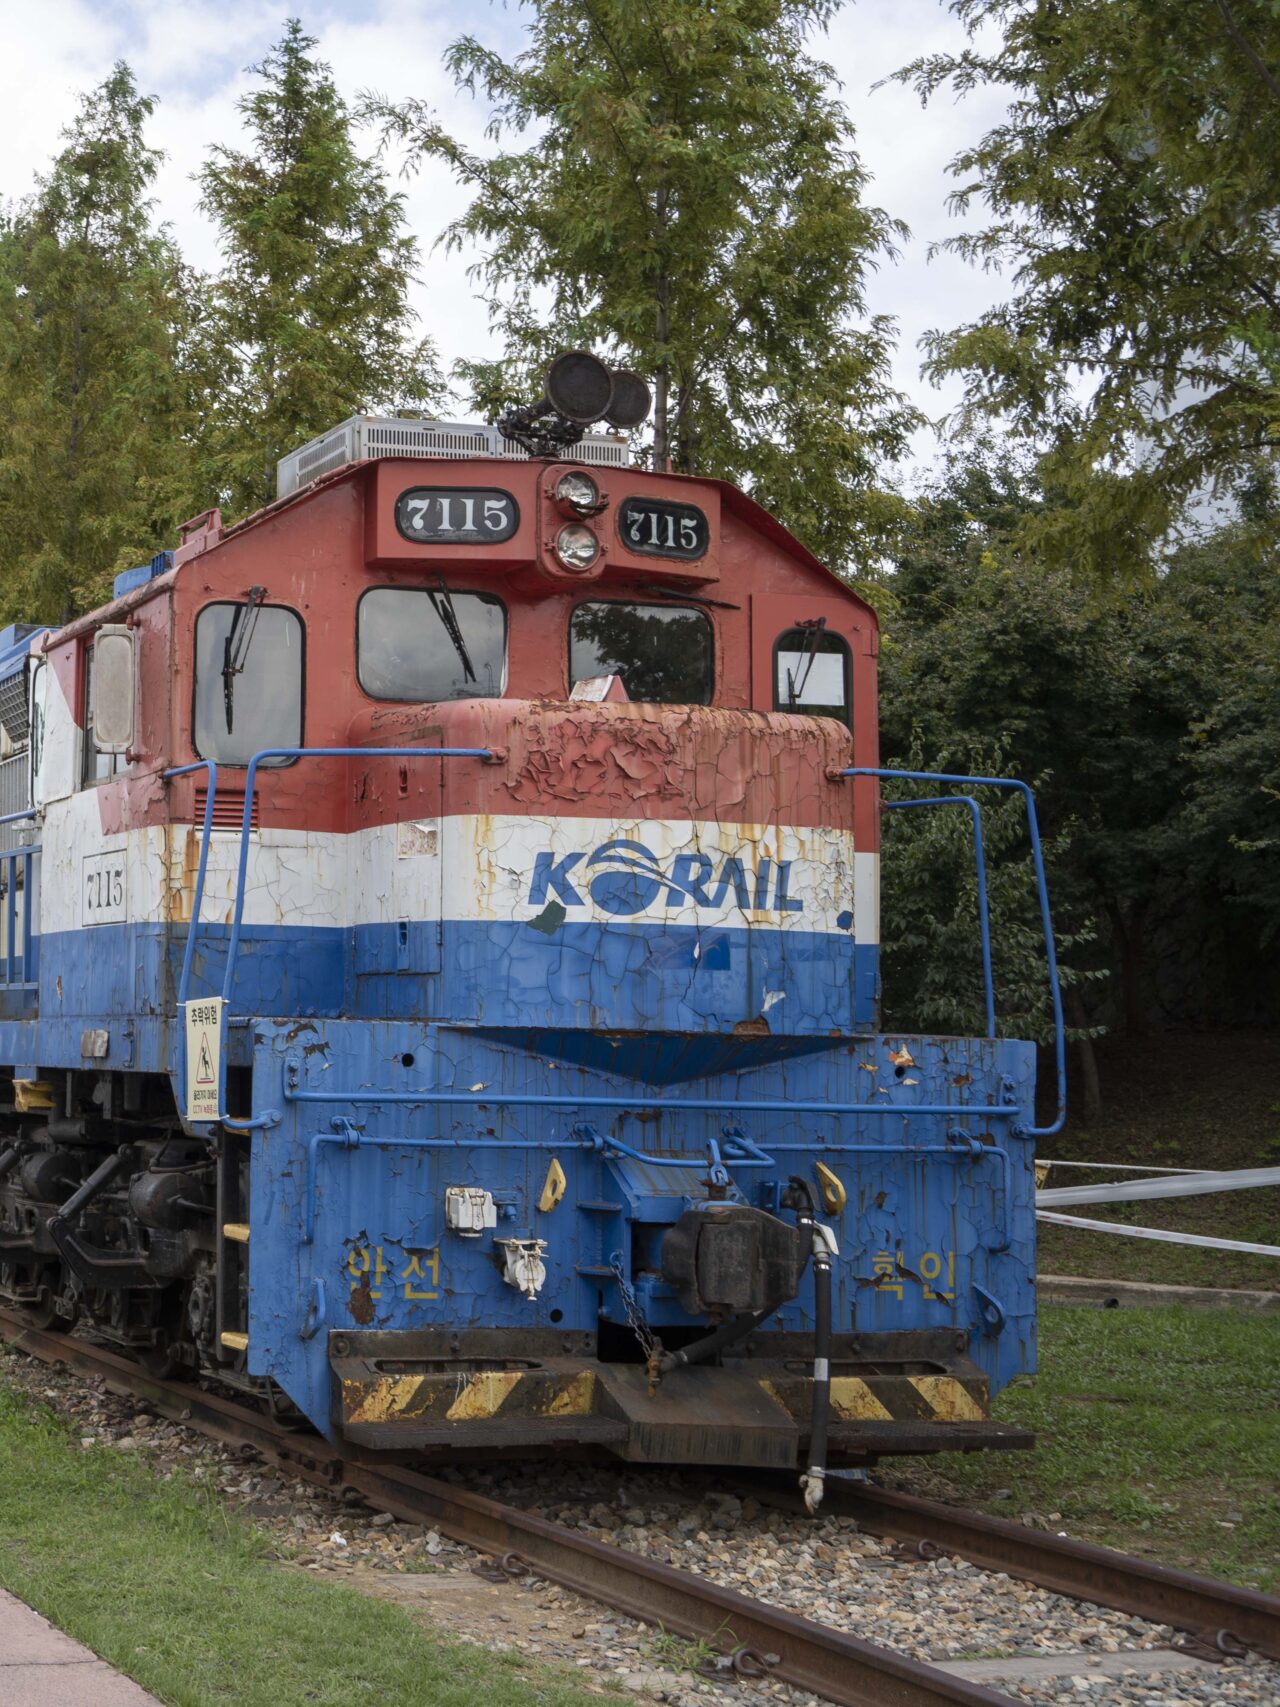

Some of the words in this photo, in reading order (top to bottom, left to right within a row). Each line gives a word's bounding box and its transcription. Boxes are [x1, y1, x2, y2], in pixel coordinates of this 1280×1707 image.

[406, 498, 508, 531] 7115
[626, 510, 698, 550] 7115
[87, 869, 123, 910] 7115
[527, 839, 804, 916] KORAIL
[191, 1004, 217, 1027] 추락위험
